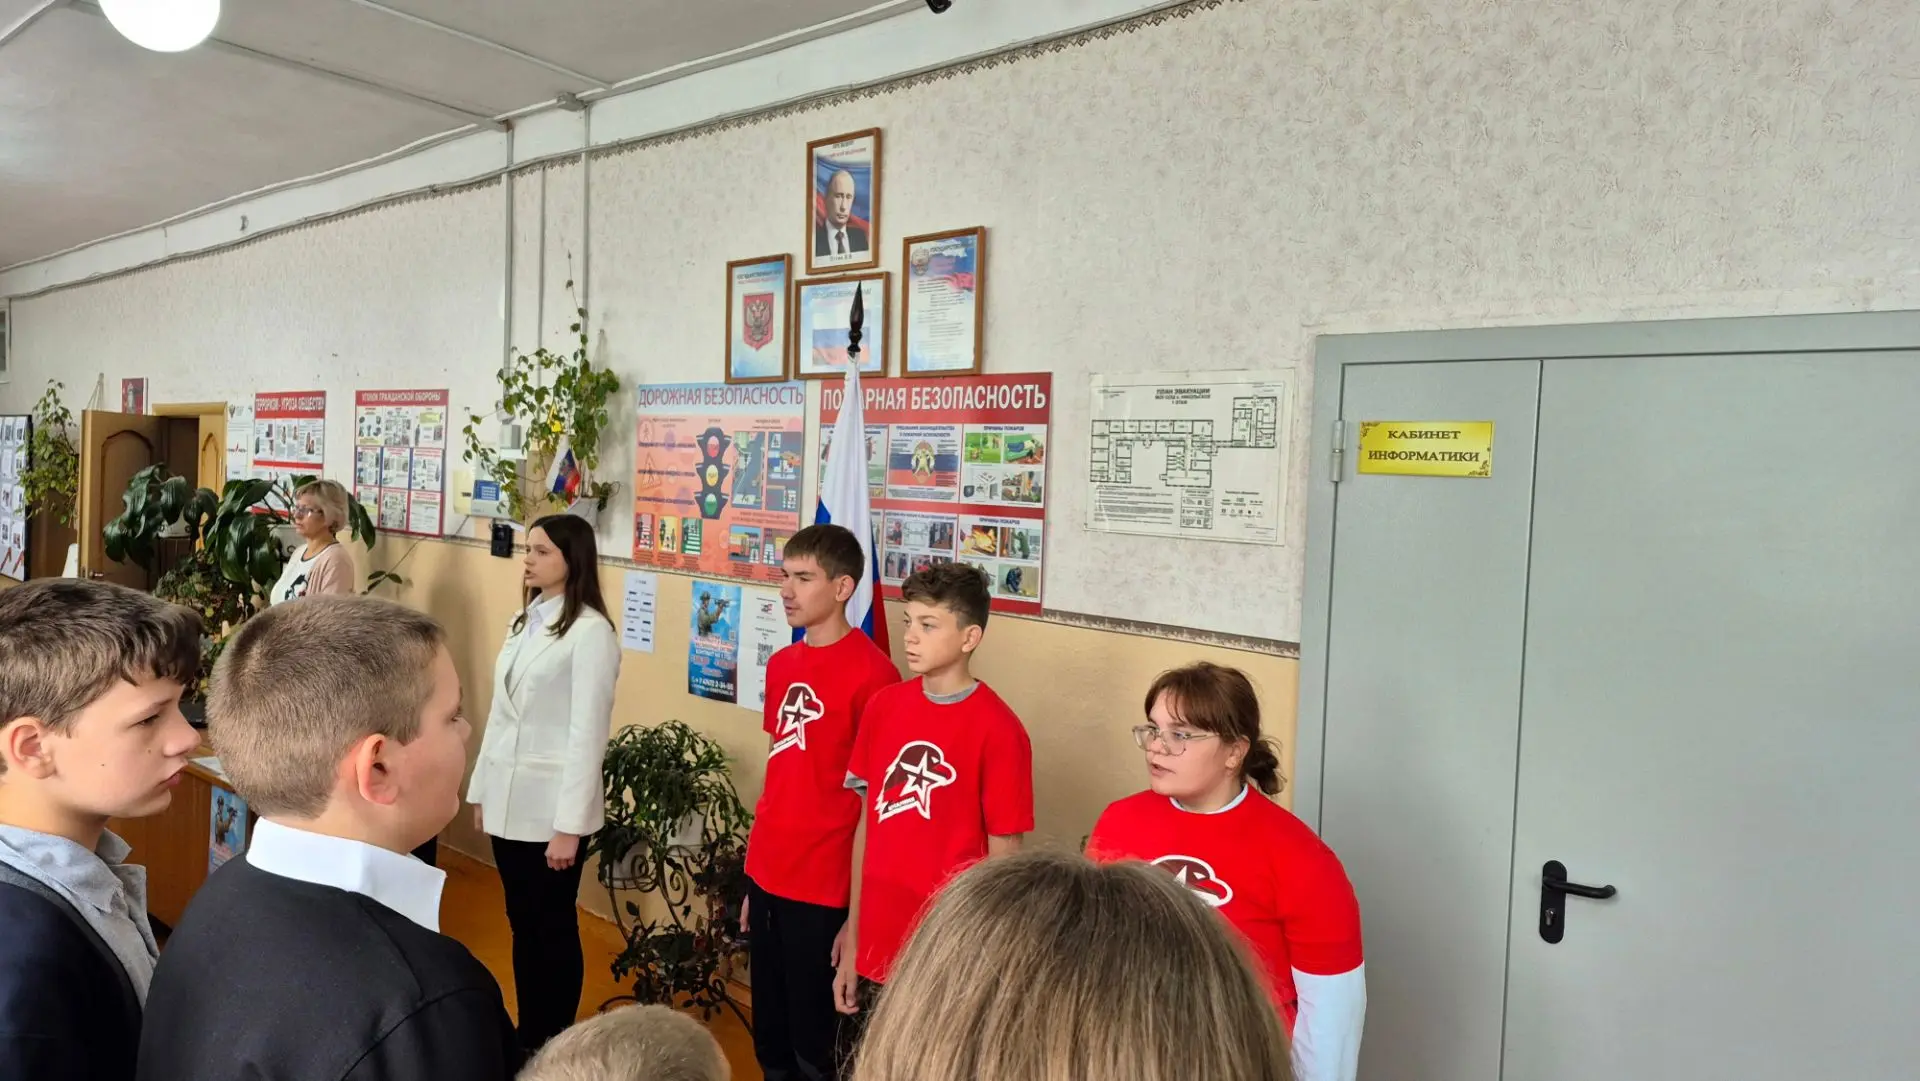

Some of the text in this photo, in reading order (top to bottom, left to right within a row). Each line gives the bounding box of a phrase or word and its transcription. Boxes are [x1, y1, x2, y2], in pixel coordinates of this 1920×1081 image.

[379, 390, 414, 402] ГРАЖДАНСКОЙ
[415, 391, 441, 402] ОБОРОНЫ
[638, 386, 804, 408] ДОРОЖНАЯ БЕЗОПАСНОСТЬ
[823, 384, 1047, 411] ПОРНАЯ БЕЗОПАСНОСТЬ
[1174, 387, 1211, 396] ЭВАКУАЦИИ
[255, 397, 278, 411] ТЕРРОРИЗМ
[1387, 430, 1461, 440] КАБИНЕТ
[1367, 450, 1480, 462] ИНФОРМАТИКИ
